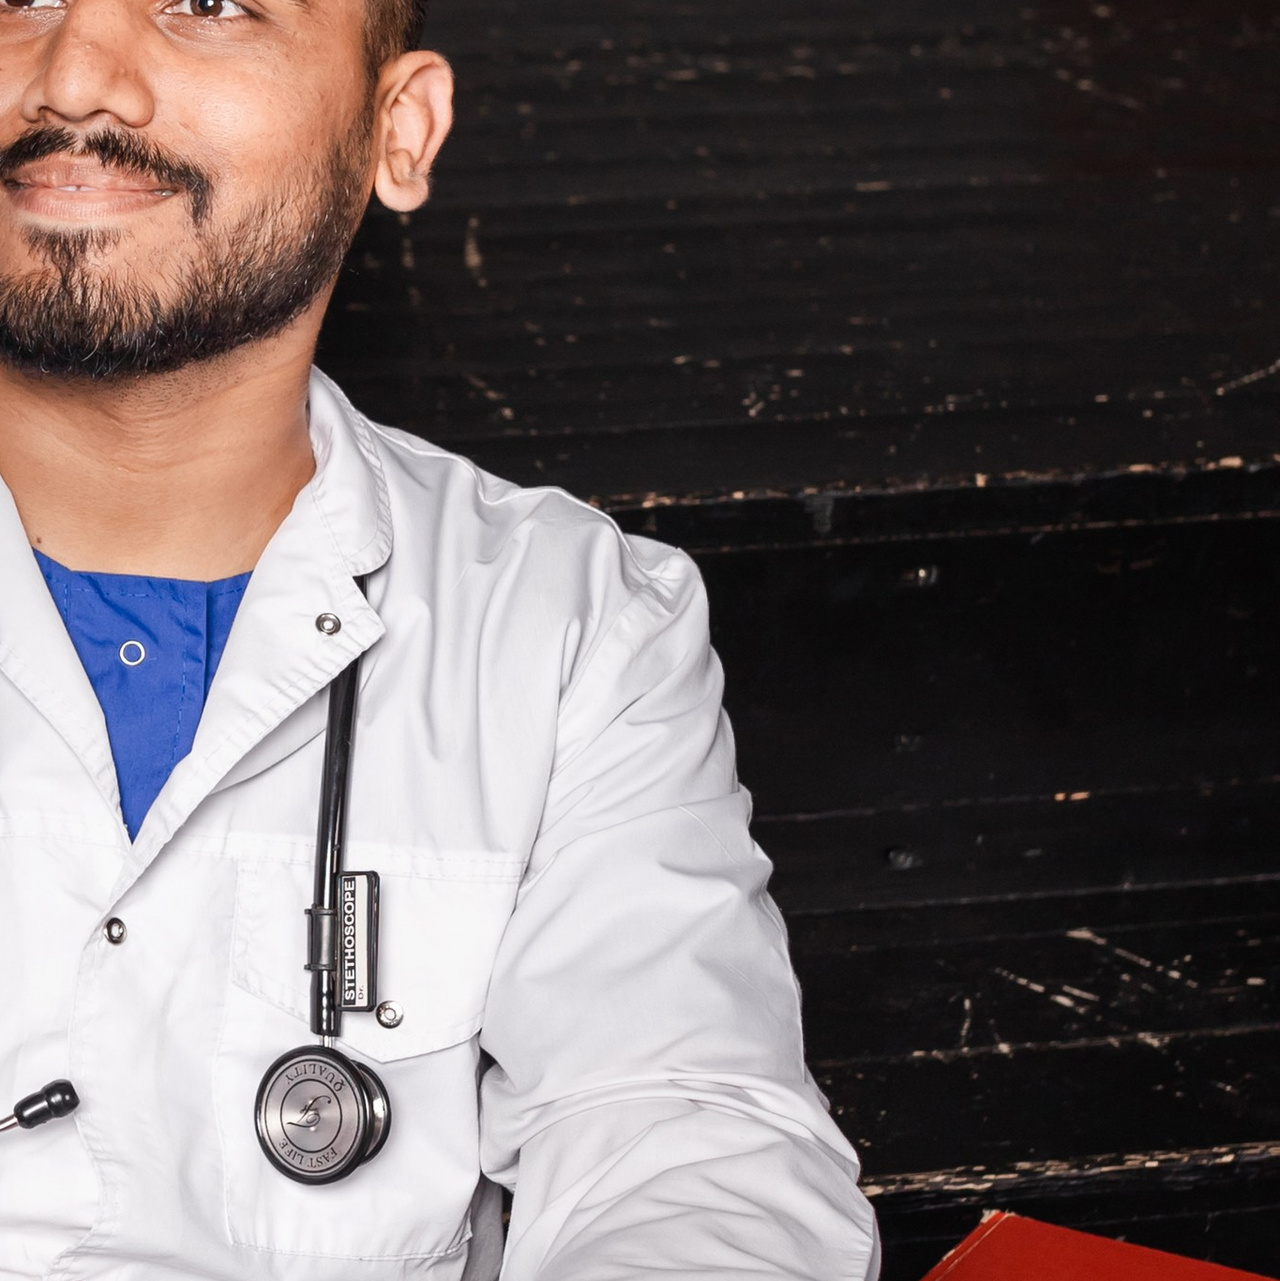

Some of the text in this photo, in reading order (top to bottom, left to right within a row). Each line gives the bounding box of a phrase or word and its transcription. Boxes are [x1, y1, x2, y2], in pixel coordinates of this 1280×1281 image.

[344, 879, 356, 1001] STETHOSCOPE
[285, 1063, 347, 1093] QUALITY
[279, 1138, 339, 1168] FAST LIFE
